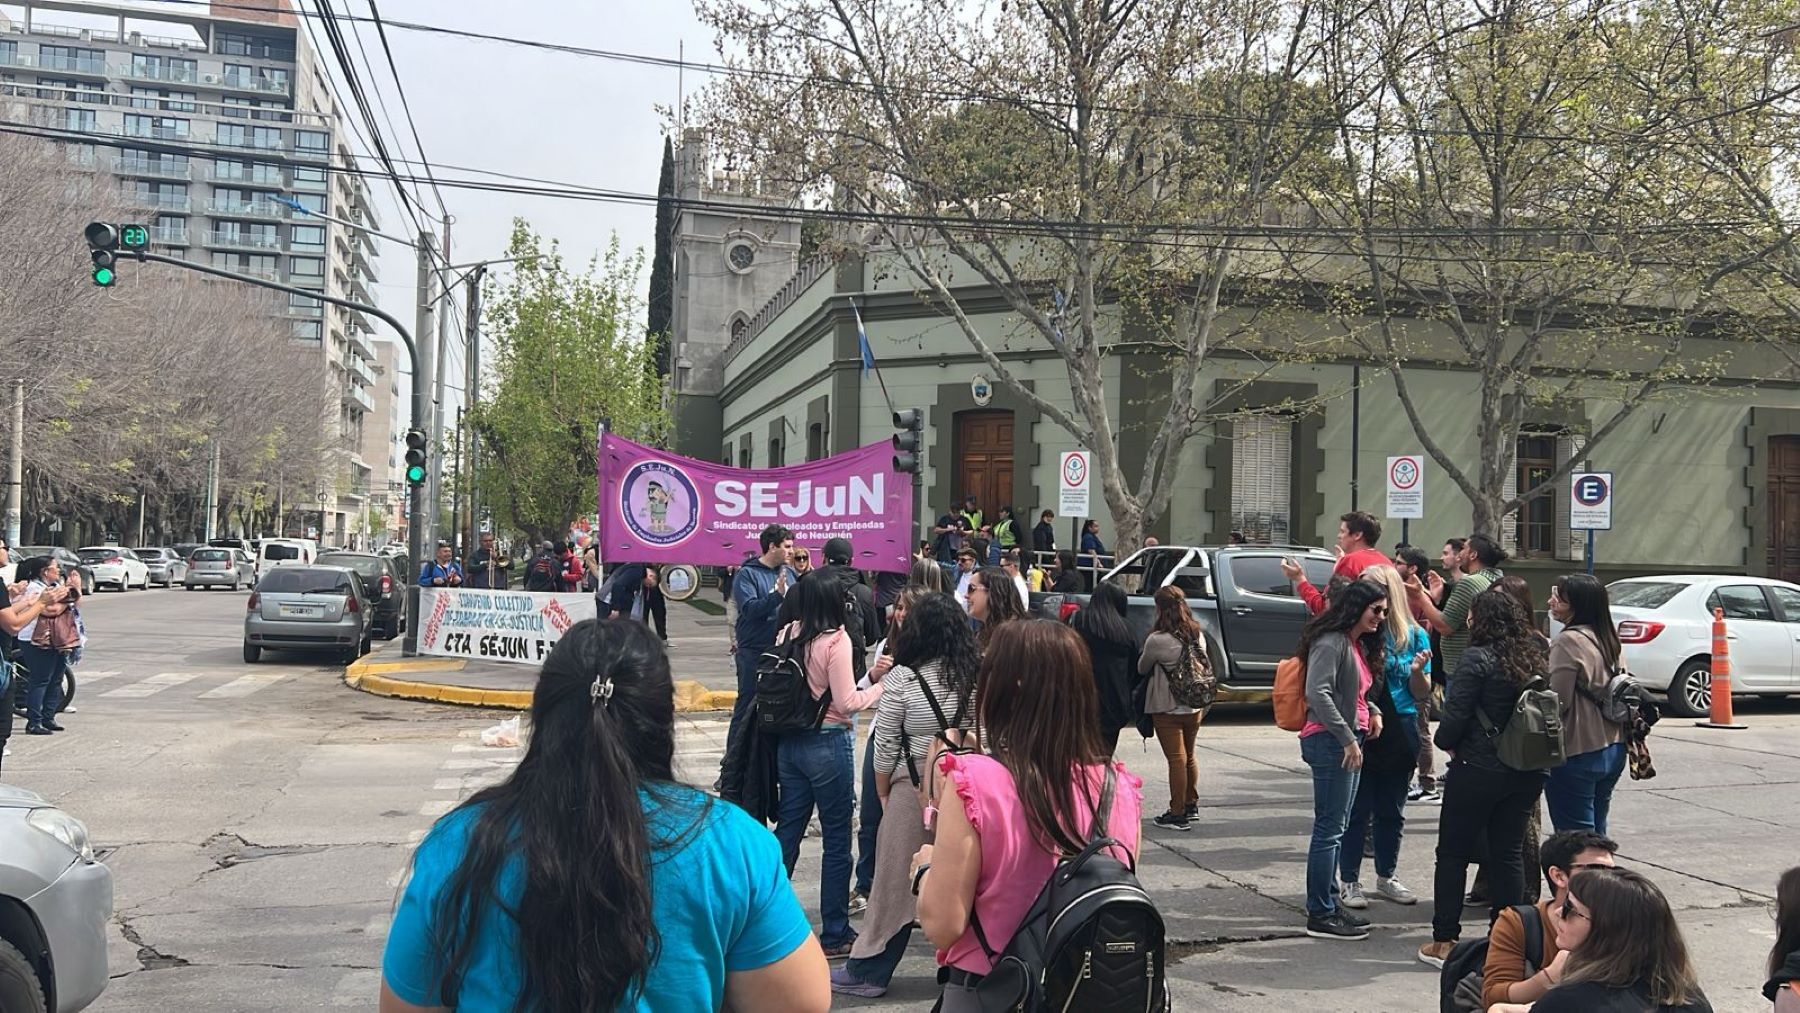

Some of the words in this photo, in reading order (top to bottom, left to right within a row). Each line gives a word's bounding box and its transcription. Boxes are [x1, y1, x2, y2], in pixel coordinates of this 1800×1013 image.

[125, 229, 145, 245] 23
[714, 472, 885, 518] SEJuN
[1583, 481, 1599, 500] E
[713, 521, 757, 531] Sindicato
[771, 521, 824, 531] pleados
[825, 523, 832, 532] y
[832, 520, 885, 532] Empleadas
[795, 531, 807, 539] de
[495, 595, 533, 612] COLECTIVO
[444, 632, 471, 654] CTA
